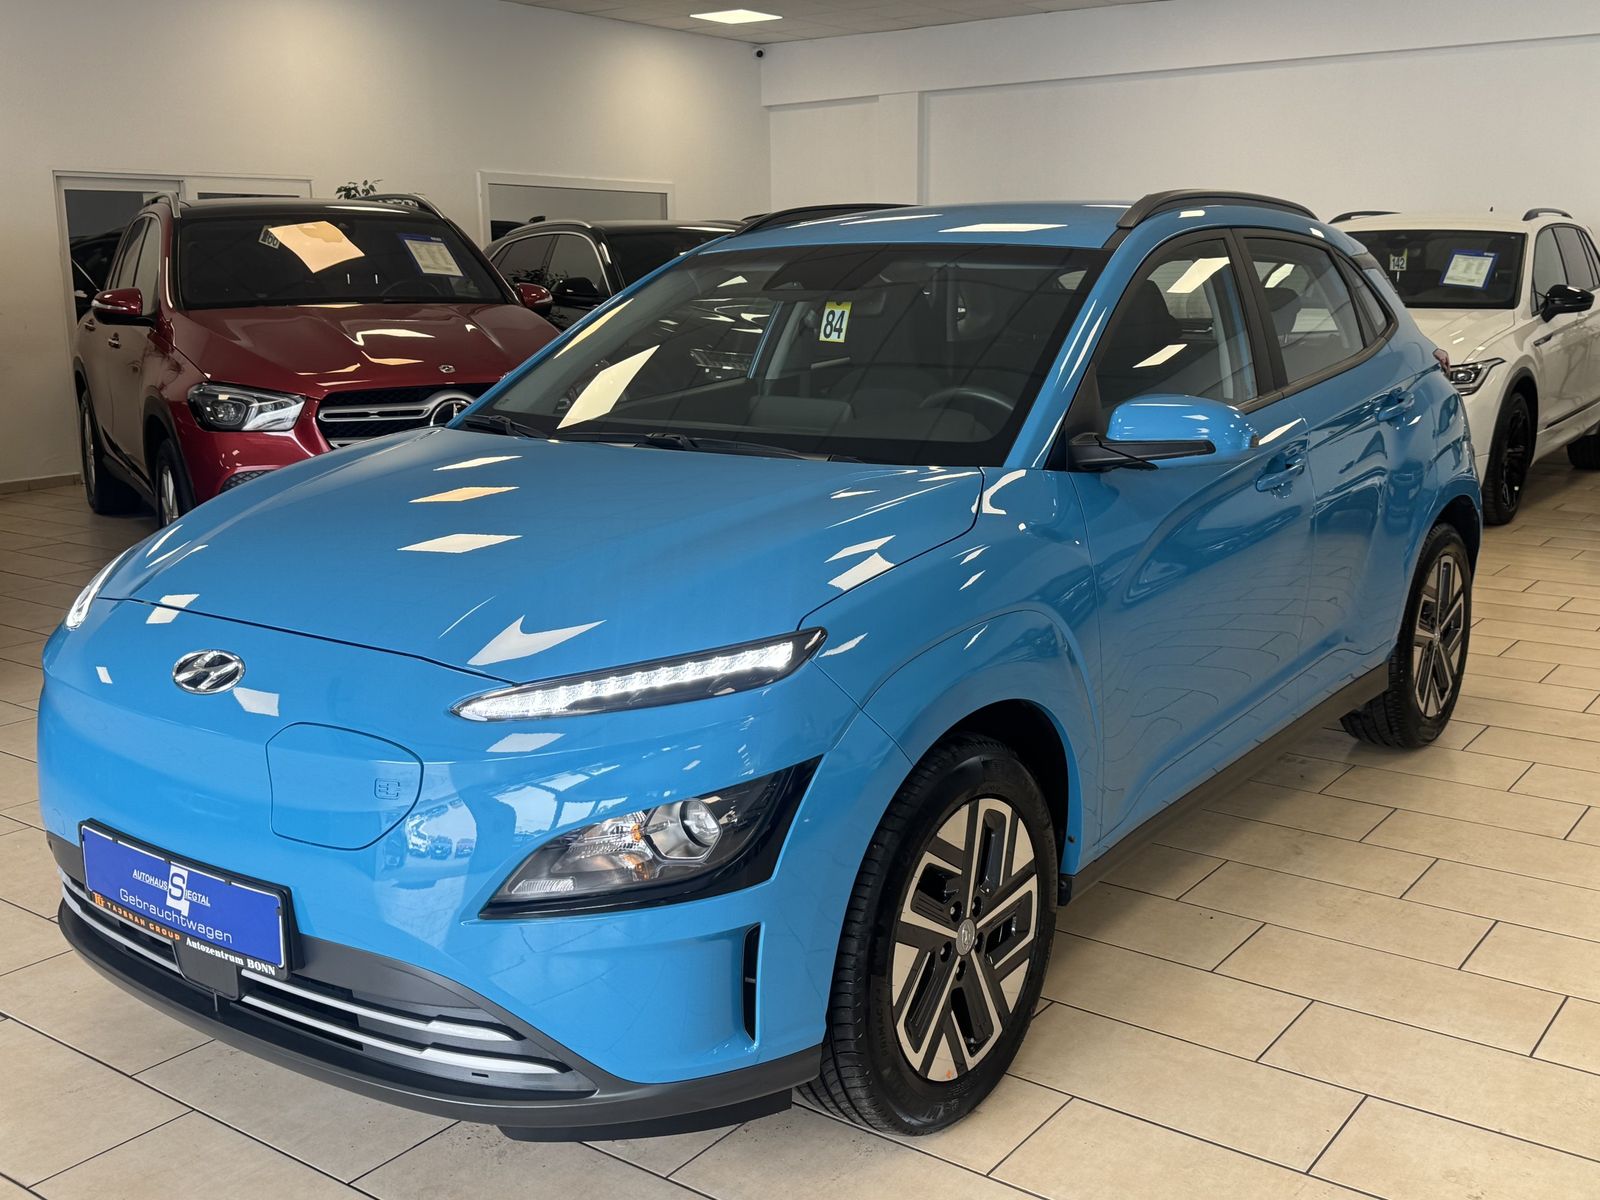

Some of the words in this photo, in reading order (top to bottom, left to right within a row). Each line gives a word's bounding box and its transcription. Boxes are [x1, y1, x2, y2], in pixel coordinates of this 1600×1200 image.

[1392, 256, 1405, 269] 142
[823, 309, 846, 339] 84
[132, 868, 168, 891] AUTOHAUS
[119, 888, 233, 944] Gebrauchtwagen
[148, 922, 181, 941] GROUP
[186, 937, 244, 966] Autozentrum
[246, 958, 276, 976] BONN
